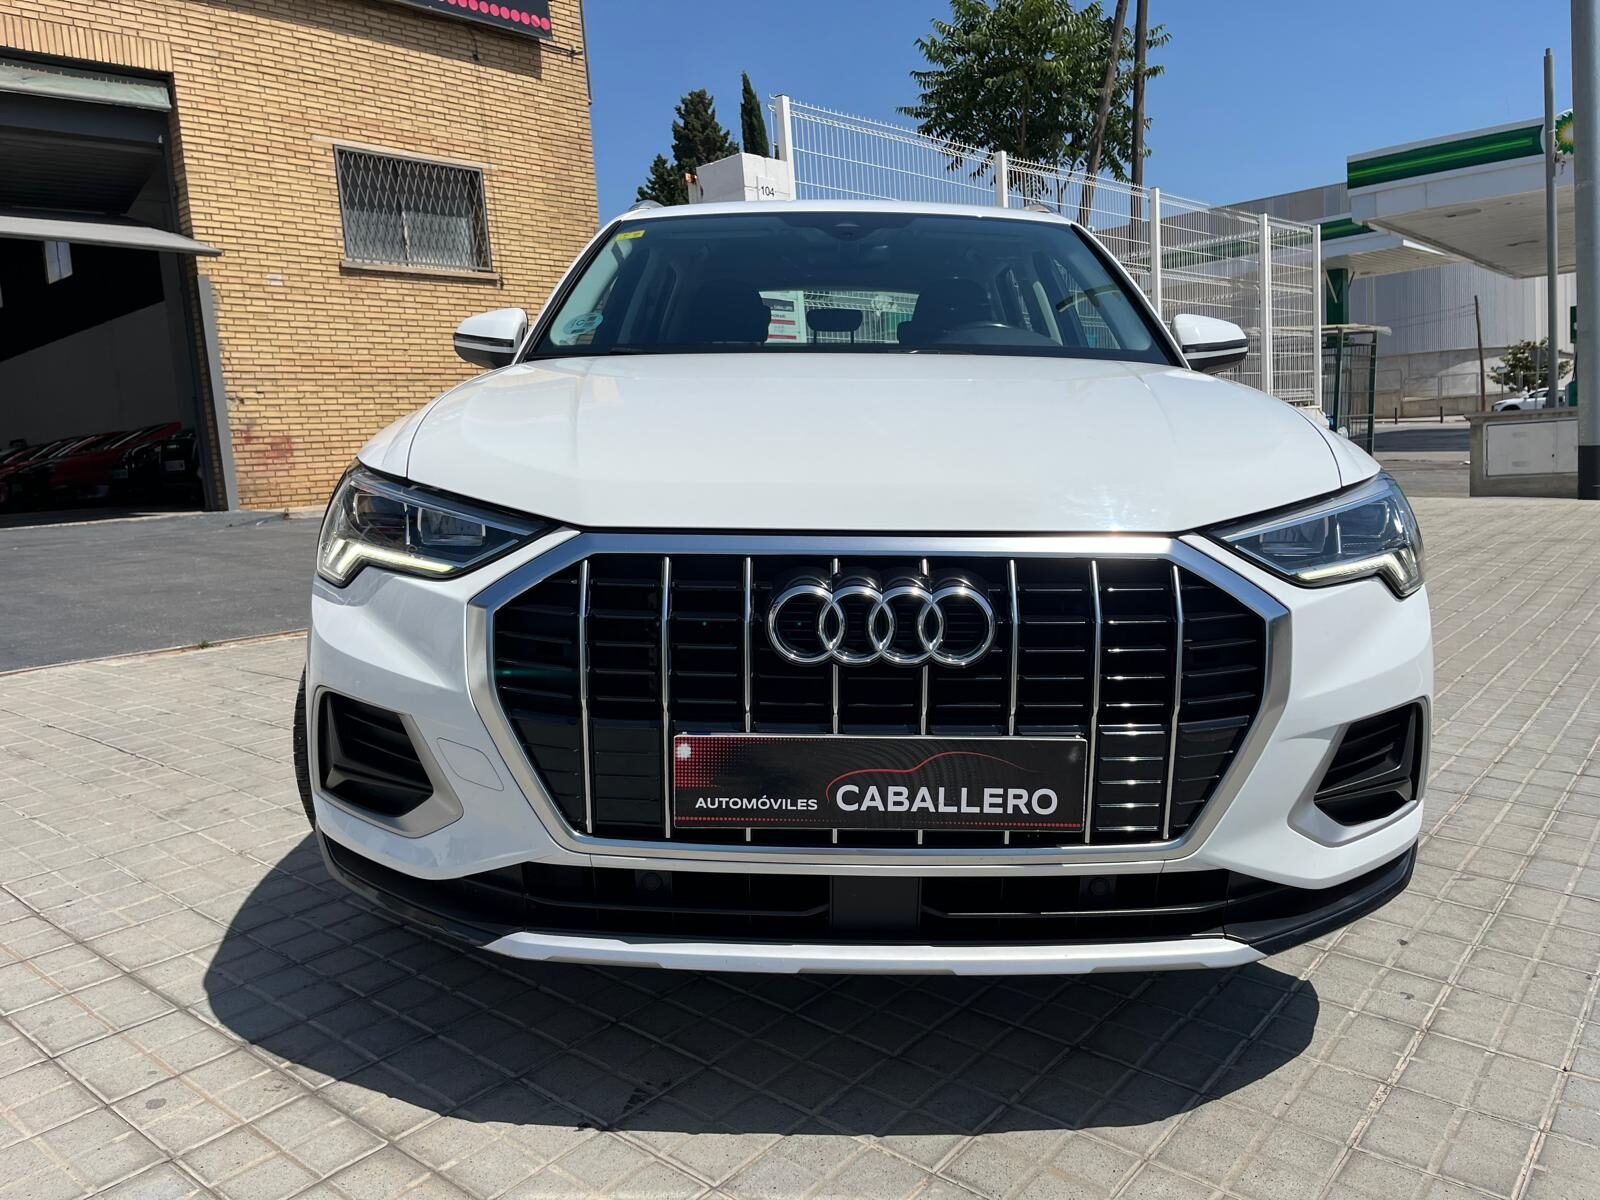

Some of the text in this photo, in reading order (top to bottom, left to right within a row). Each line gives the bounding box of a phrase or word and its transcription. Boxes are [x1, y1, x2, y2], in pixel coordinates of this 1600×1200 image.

[761, 186, 775, 197] 104
[695, 784, 1058, 815] AUTOMÓVILES CABALLERO
